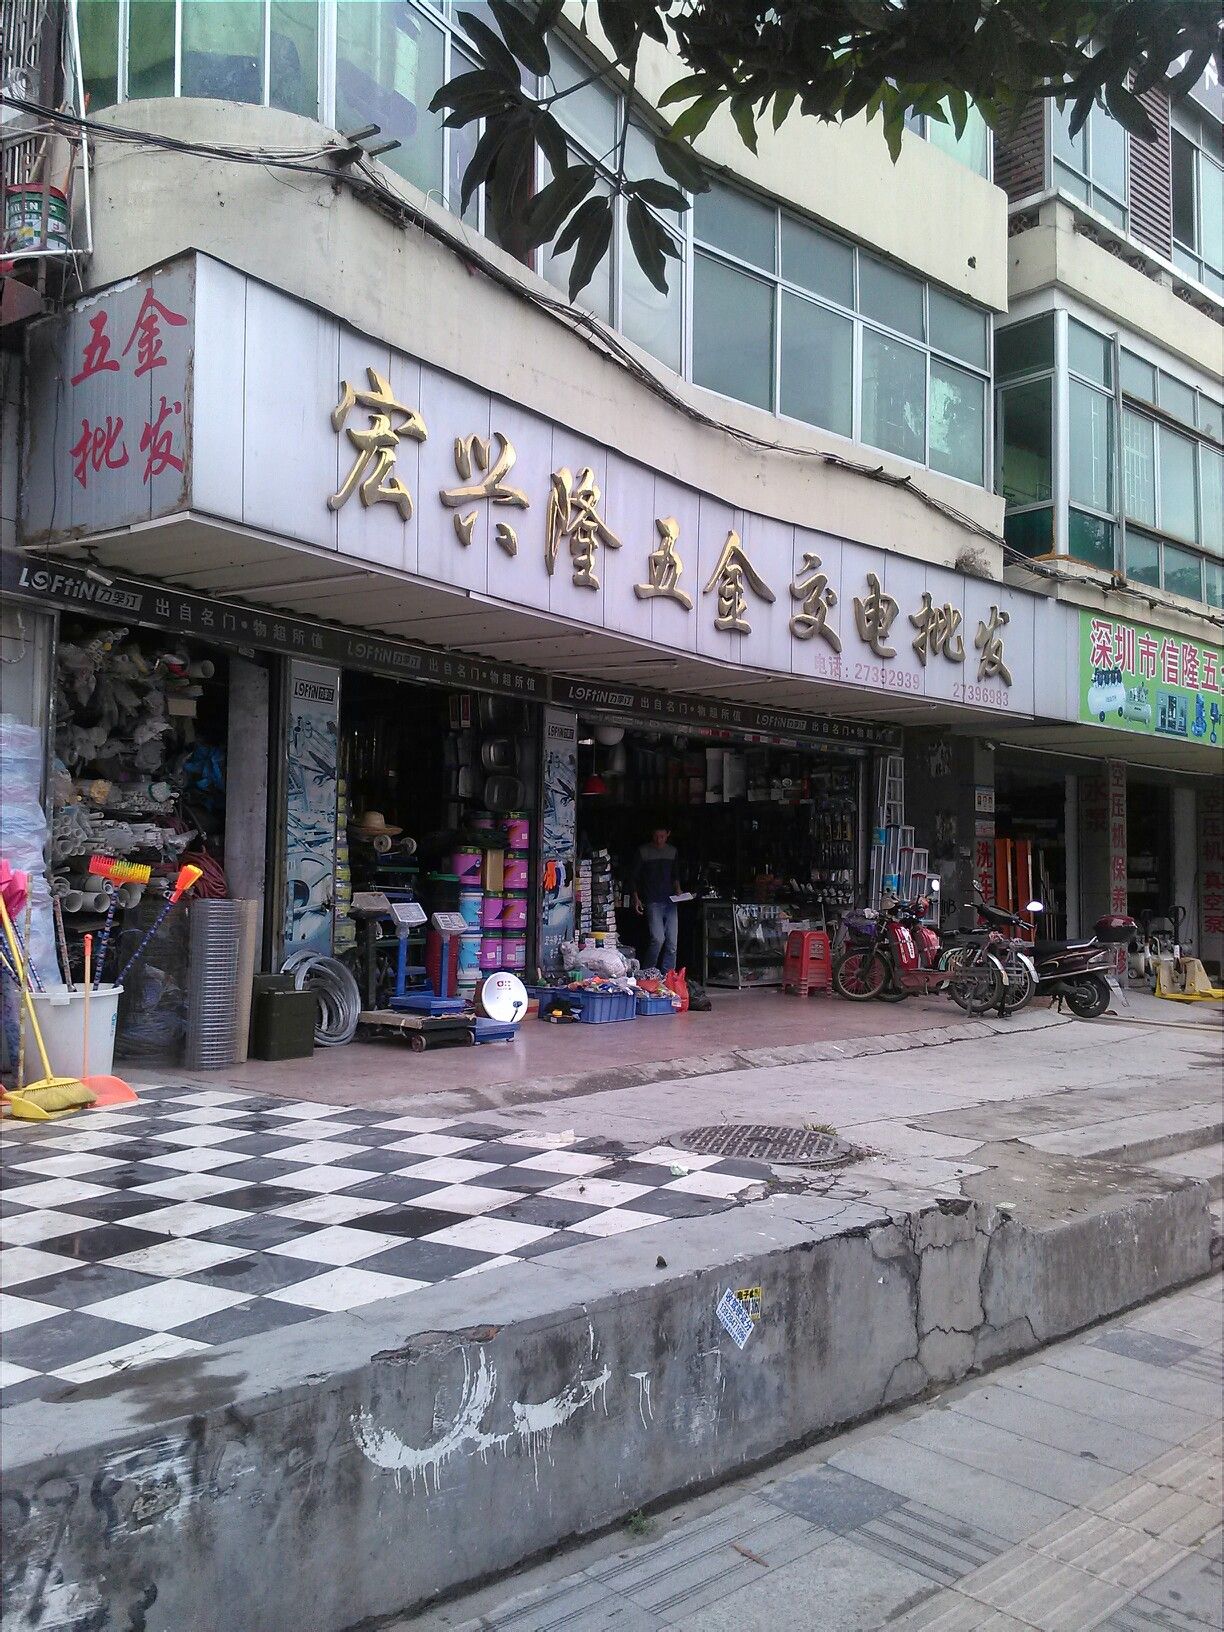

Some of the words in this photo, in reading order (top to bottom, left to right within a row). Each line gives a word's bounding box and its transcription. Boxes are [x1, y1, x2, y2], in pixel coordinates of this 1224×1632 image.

[71, 288, 187, 386] 五金
[69, 396, 184, 488] 批发
[327, 366, 1012, 687] 宏兴隆五金交电批发
[953, 682, 1010, 708] 27396983
[1090, 617, 1224, 696] 深圳市信隆五
